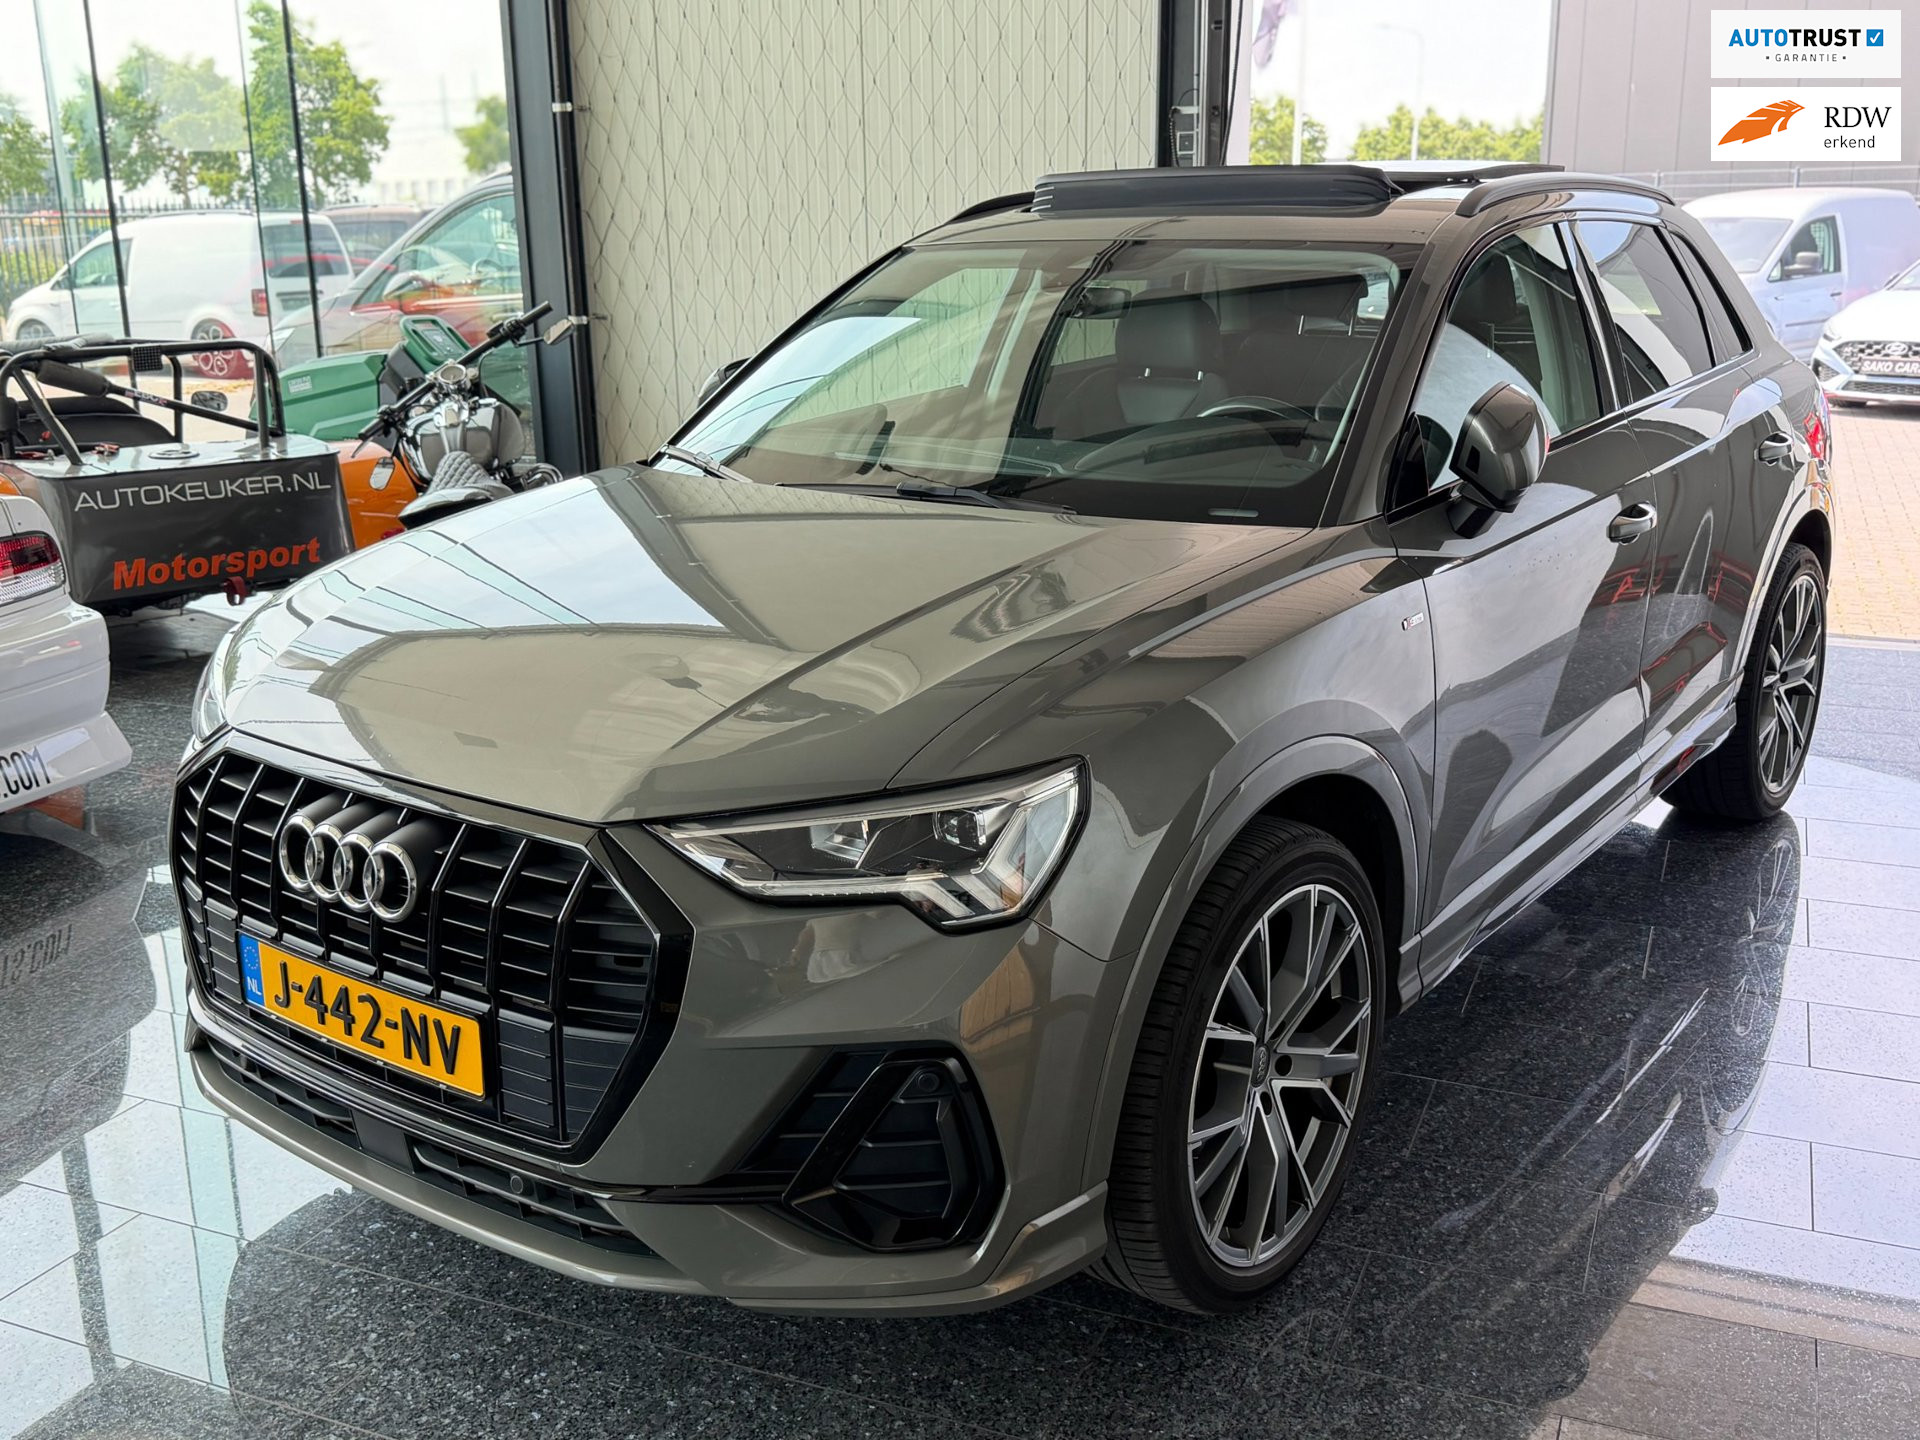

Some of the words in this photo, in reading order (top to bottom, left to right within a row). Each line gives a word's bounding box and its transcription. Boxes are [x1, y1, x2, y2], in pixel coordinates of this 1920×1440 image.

[1861, 360, 1893, 372] SAKO
[1894, 361, 1920, 374] CAR
[74, 472, 331, 512] AUTOKEUKER.NL
[113, 537, 320, 590] Motorsport
[246, 975, 262, 996] NL
[274, 960, 460, 1075] J-442-NV
